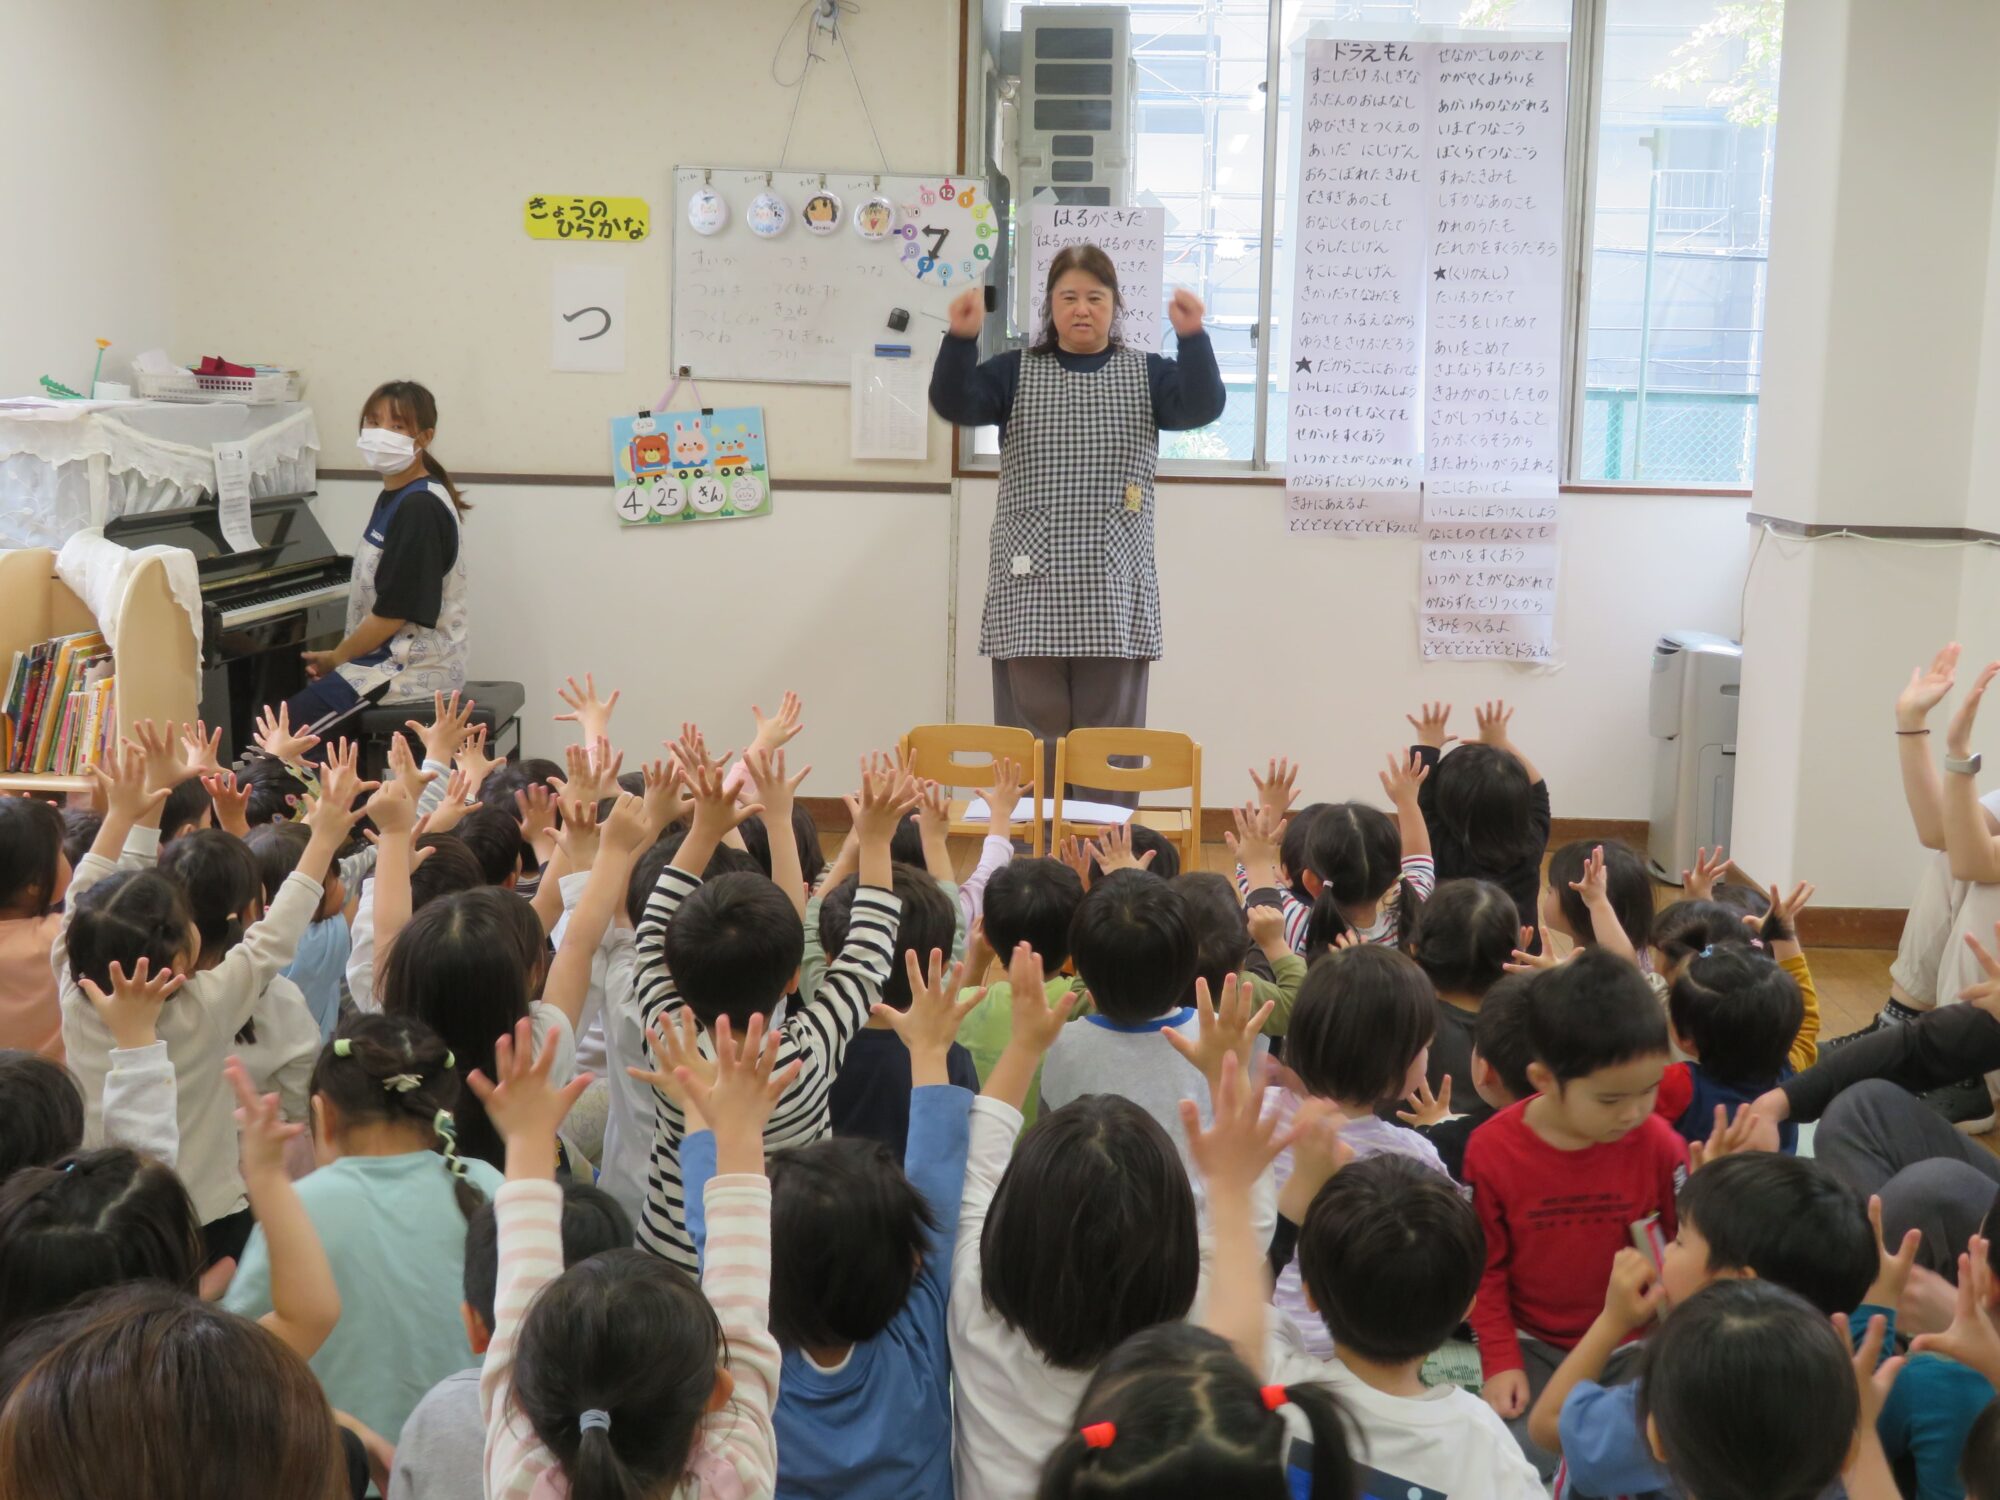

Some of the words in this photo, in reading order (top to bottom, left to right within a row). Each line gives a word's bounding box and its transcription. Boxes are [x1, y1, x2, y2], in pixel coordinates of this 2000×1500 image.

[1335, 42, 1414, 62] ドラえもん
[923, 195, 936, 204] 11
[941, 187, 954, 198] 12
[529, 197, 608, 220] きょうの
[1054, 209, 1144, 228] はるがきた
[563, 306, 611, 341] つ
[623, 490, 644, 515] 4
[656, 487, 678, 507] 25
[1291, 495, 1369, 511] きみにあえるよ
[1426, 616, 1511, 633] きみをつくるよ
